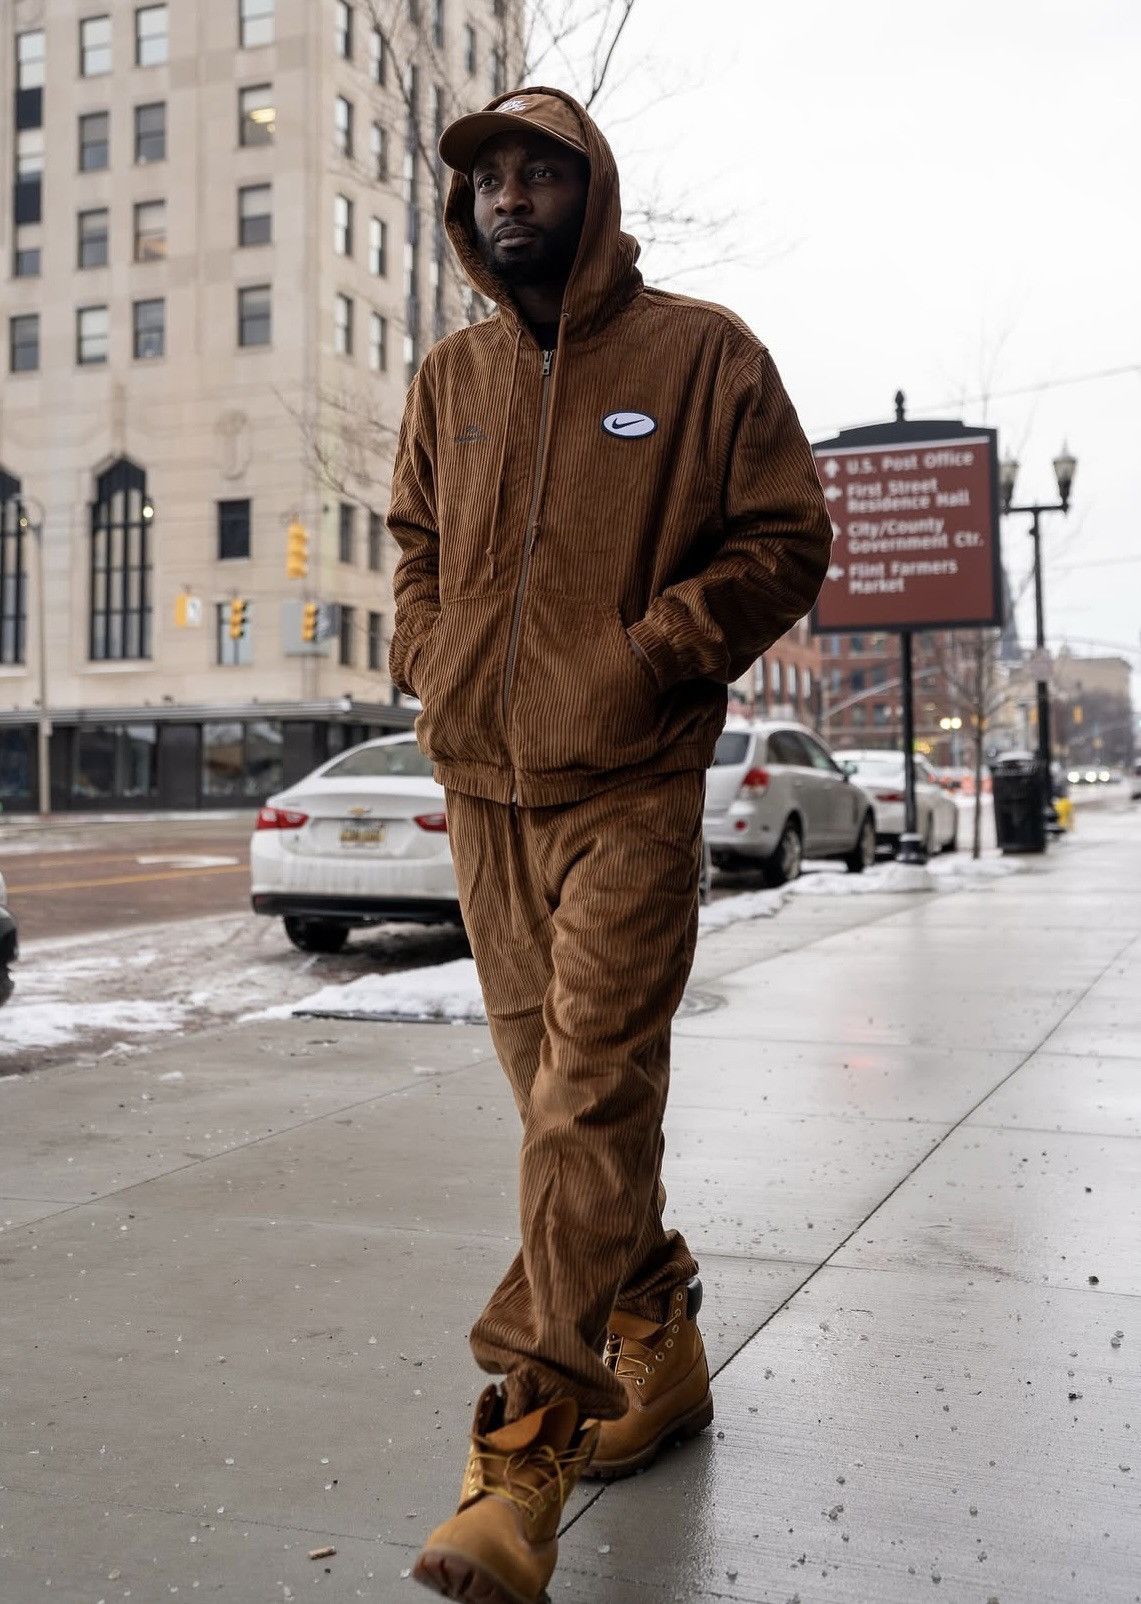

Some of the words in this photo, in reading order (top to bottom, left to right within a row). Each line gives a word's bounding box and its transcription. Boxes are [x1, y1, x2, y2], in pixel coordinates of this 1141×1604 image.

[847, 458, 874, 475] U.S.
[882, 454, 918, 471] Post
[924, 450, 974, 469] Office
[847, 482, 882, 498] First
[888, 478, 937, 496] Street
[848, 495, 930, 513] Residence
[936, 490, 970, 508] Hall
[848, 518, 945, 538] City/County
[848, 534, 948, 554] Government
[849, 562, 885, 579] Flint
[891, 559, 959, 576] Farmers
[849, 577, 905, 595] Market
